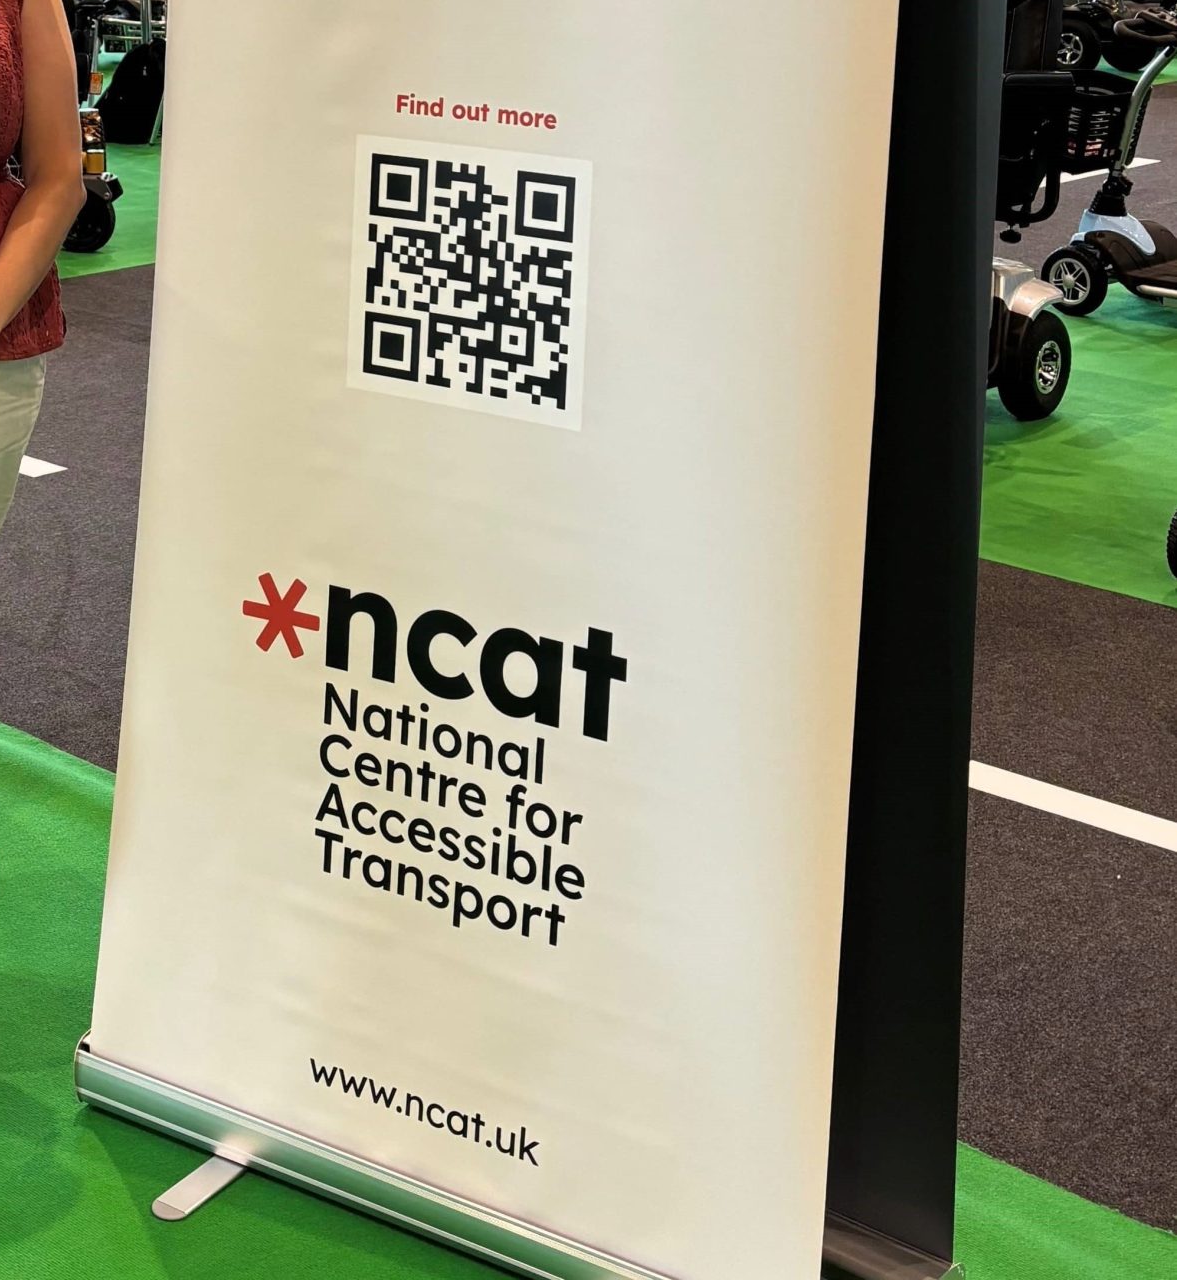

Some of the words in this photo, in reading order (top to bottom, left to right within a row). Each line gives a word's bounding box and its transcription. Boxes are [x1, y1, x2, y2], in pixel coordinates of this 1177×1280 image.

[396, 93, 444, 117] Find
[452, 104, 490, 122] out
[498, 107, 557, 129] more
[325, 584, 628, 742] ncat
[323, 682, 545, 784] National
[315, 783, 585, 900] Accessible
[319, 734, 487, 818] Centre
[505, 784, 583, 845] for
[314, 828, 566, 947] Transport
[310, 1058, 540, 1167] www.ncat.uk
